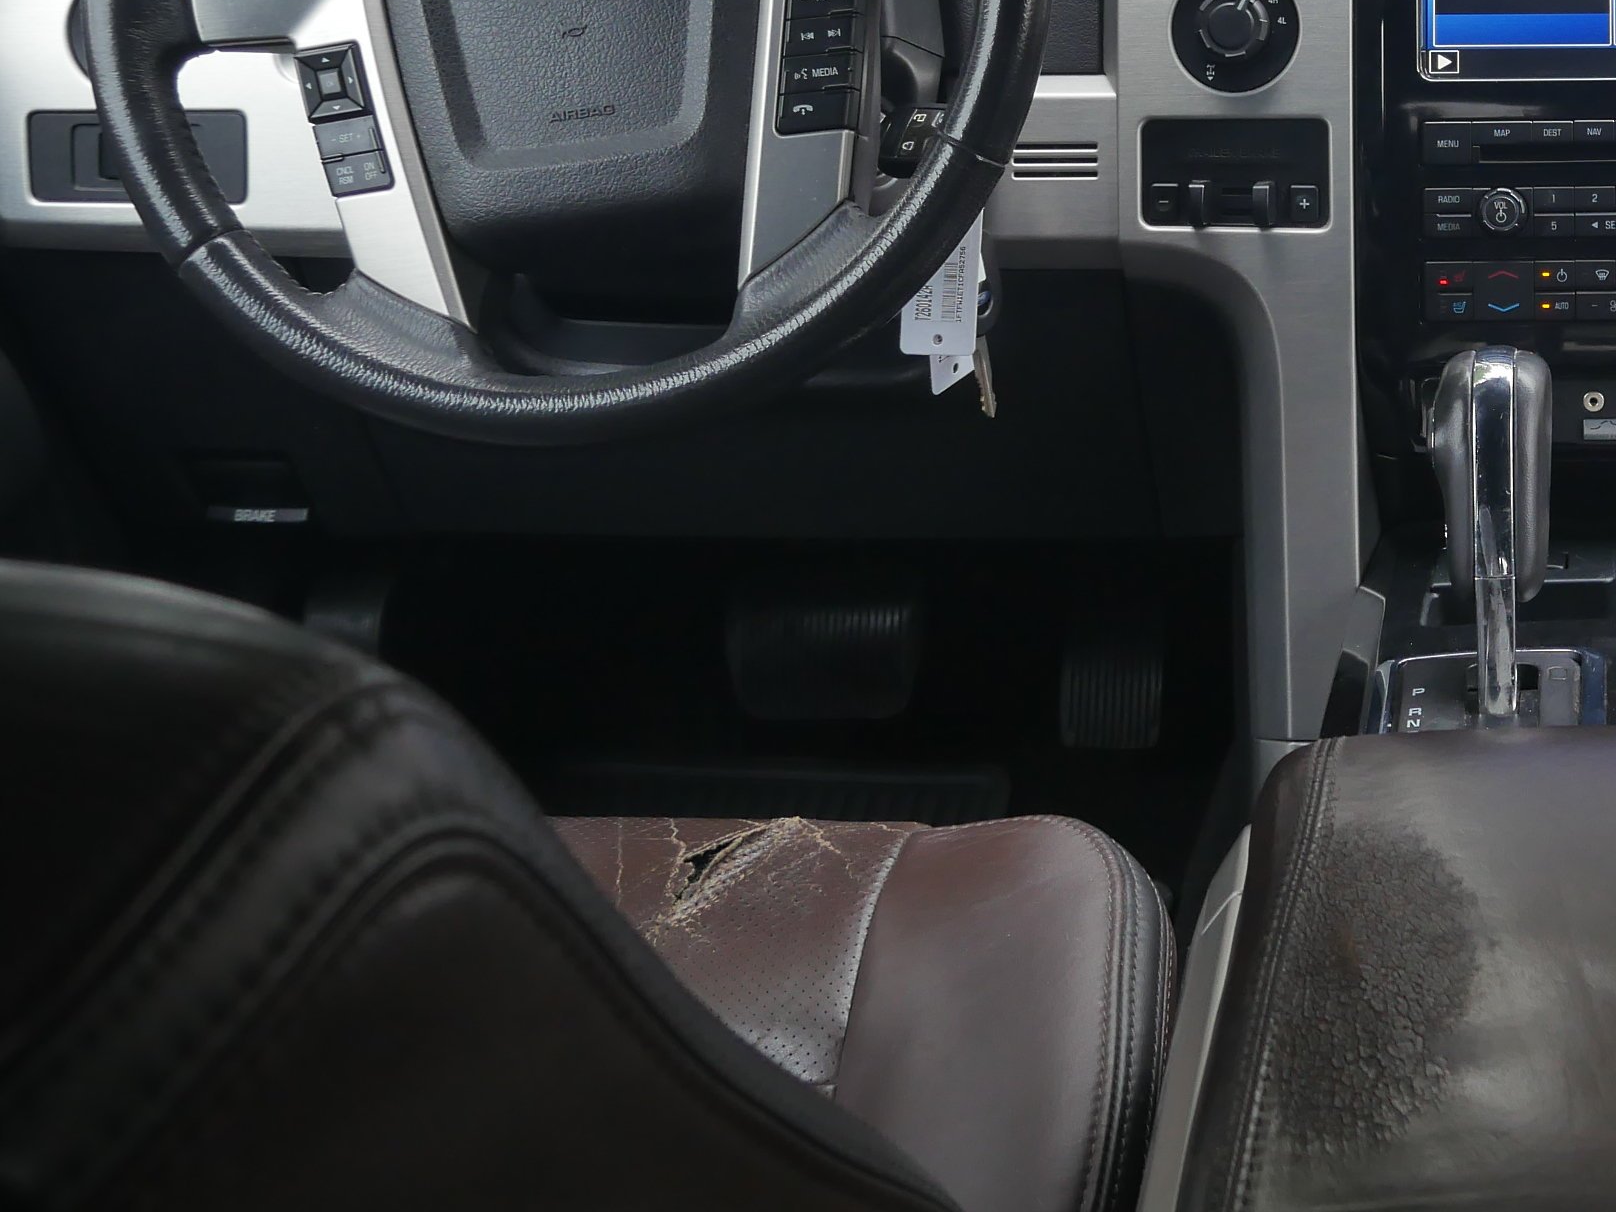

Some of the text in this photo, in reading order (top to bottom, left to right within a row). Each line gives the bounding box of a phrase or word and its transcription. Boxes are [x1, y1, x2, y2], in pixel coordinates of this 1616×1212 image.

[1277, 16, 1287, 25] 4L
[811, 66, 839, 78] MEDIA
[550, 104, 616, 124] AIRBAG
[1493, 128, 1511, 138] MAP
[1543, 128, 1562, 137] DEST
[1586, 127, 1603, 136] NAV
[338, 132, 354, 143] SET
[1436, 140, 1460, 148] MENU
[363, 162, 376, 171] ON
[364, 170, 378, 181] OFF
[338, 176, 354, 186] RSM
[1437, 195, 1461, 204] RADIO
[1591, 193, 1598, 203] 2
[1494, 201, 1508, 210] VOL
[1437, 223, 1461, 232] MEDIA
[1551, 222, 1558, 230] 5
[1554, 301, 1570, 310] AUTO
[234, 508, 277, 523] BRAKE
[1411, 687, 1426, 697] P
[1408, 706, 1422, 717] R
[1406, 718, 1422, 728] N
